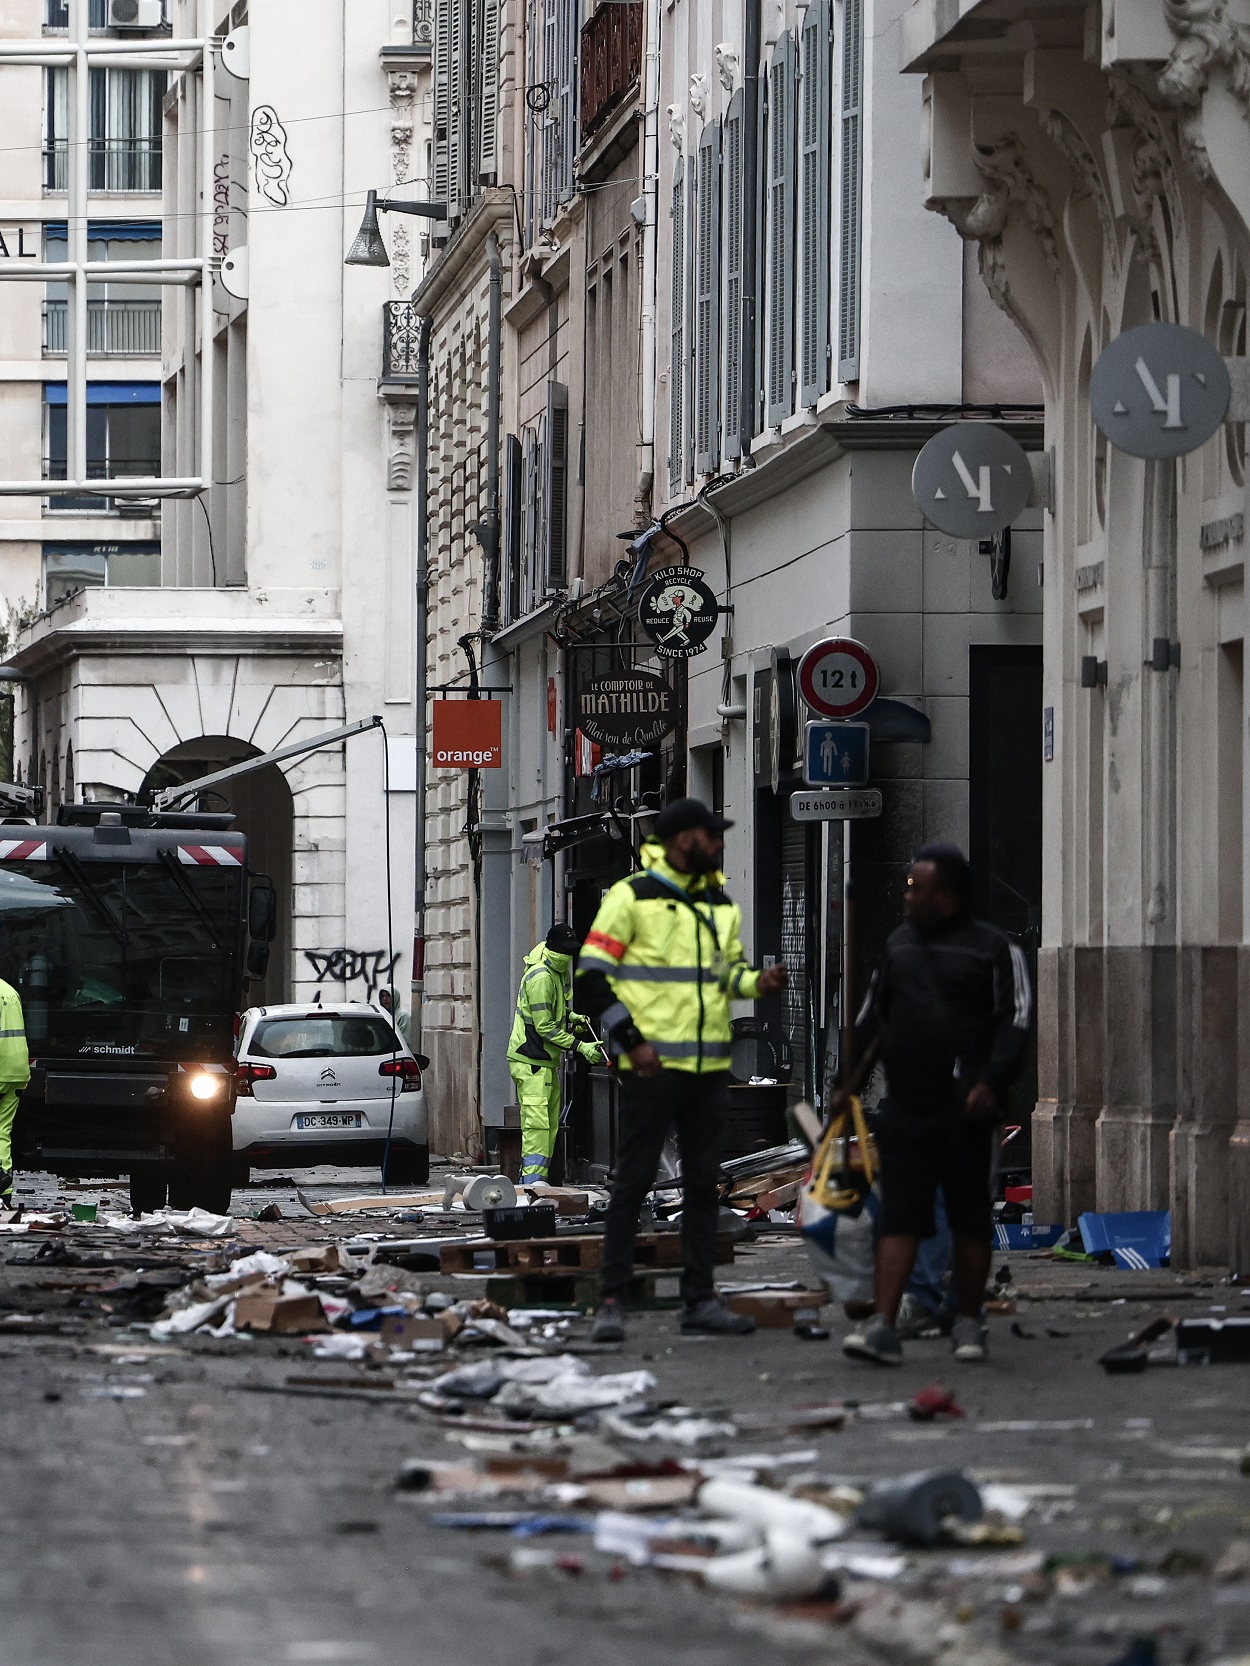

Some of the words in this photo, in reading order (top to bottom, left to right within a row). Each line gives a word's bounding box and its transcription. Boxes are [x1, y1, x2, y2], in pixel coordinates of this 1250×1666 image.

[654, 567, 675, 580] KILO
[677, 567, 703, 578] SHOP
[664, 578, 692, 586] RECYCLE
[646, 617, 670, 625] REDUCE
[657, 645, 683, 657] SINCE
[685, 644, 705, 656] 1974
[591, 683, 598, 691] LE
[600, 680, 643, 691] COMPTOIR
[646, 681, 654, 689] DE
[820, 670, 844, 688] 12
[850, 671, 858, 688] t
[581, 692, 669, 714] MATHILDE
[585, 720, 619, 744] Maison
[622, 731, 631, 744] de
[437, 750, 492, 764] orange
[799, 801, 810, 810] DE
[813, 801, 836, 810] 6h00
[94, 1045, 135, 1054] schmidt
